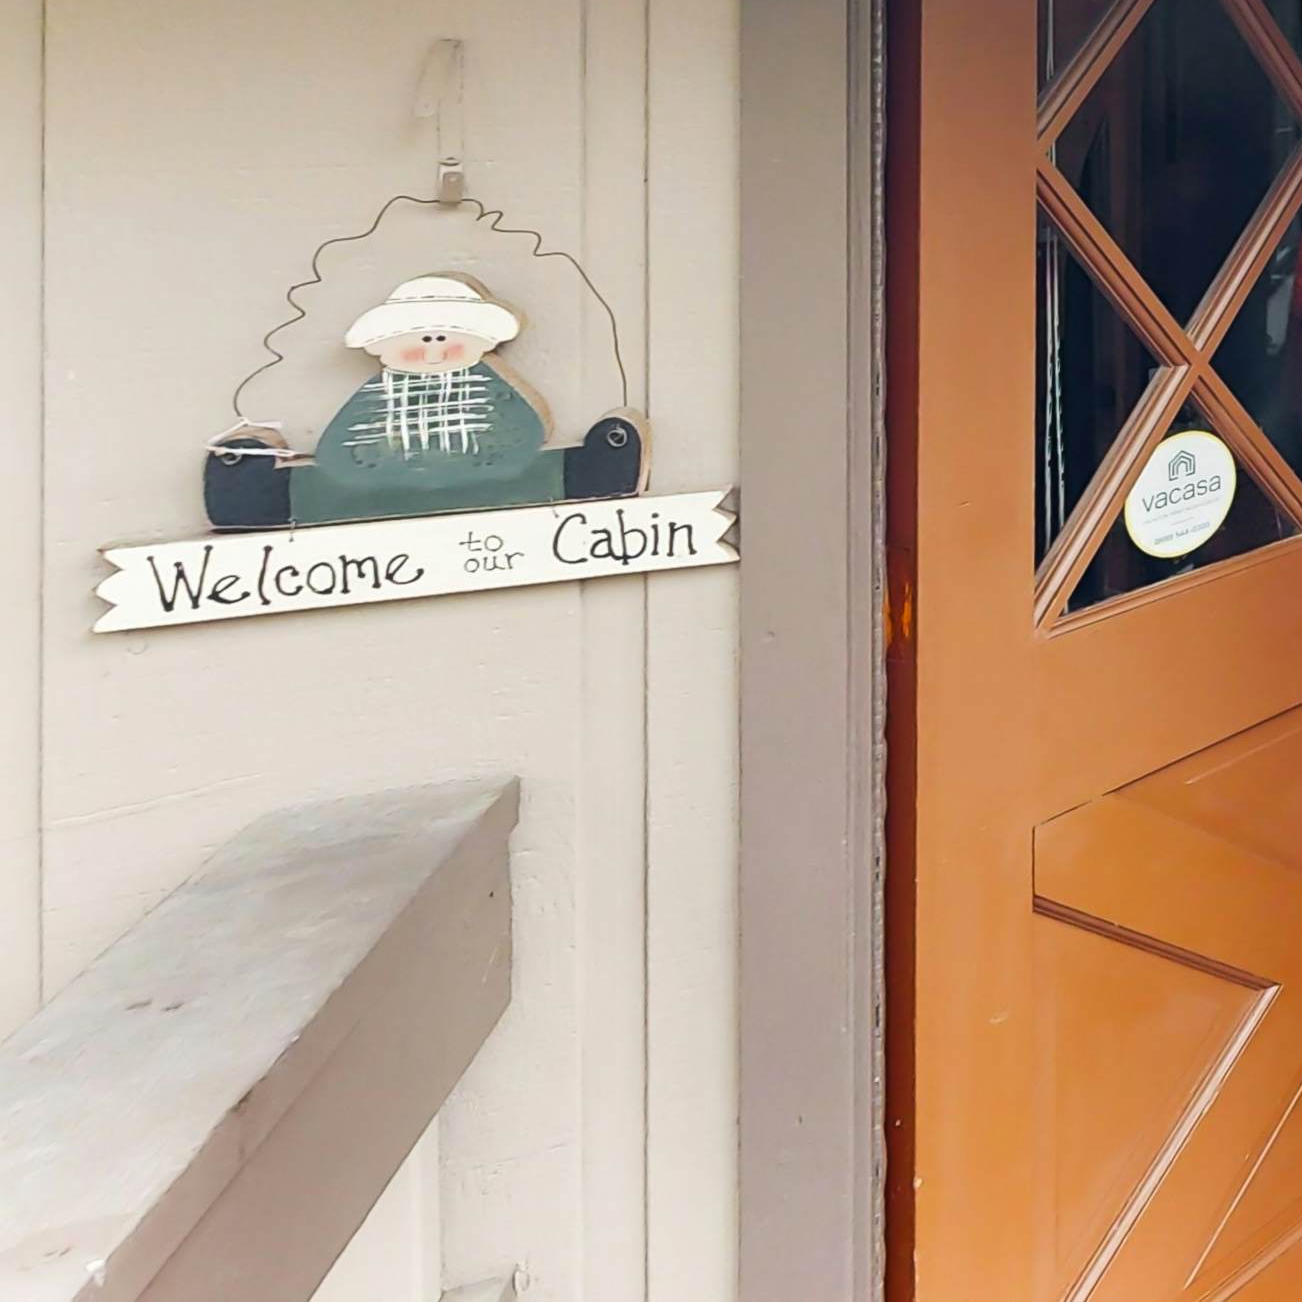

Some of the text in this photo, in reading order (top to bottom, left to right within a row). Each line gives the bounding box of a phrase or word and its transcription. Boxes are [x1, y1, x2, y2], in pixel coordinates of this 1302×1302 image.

[1142, 475, 1222, 513] vacasa
[146, 508, 698, 613] Welcome to our Cabin
